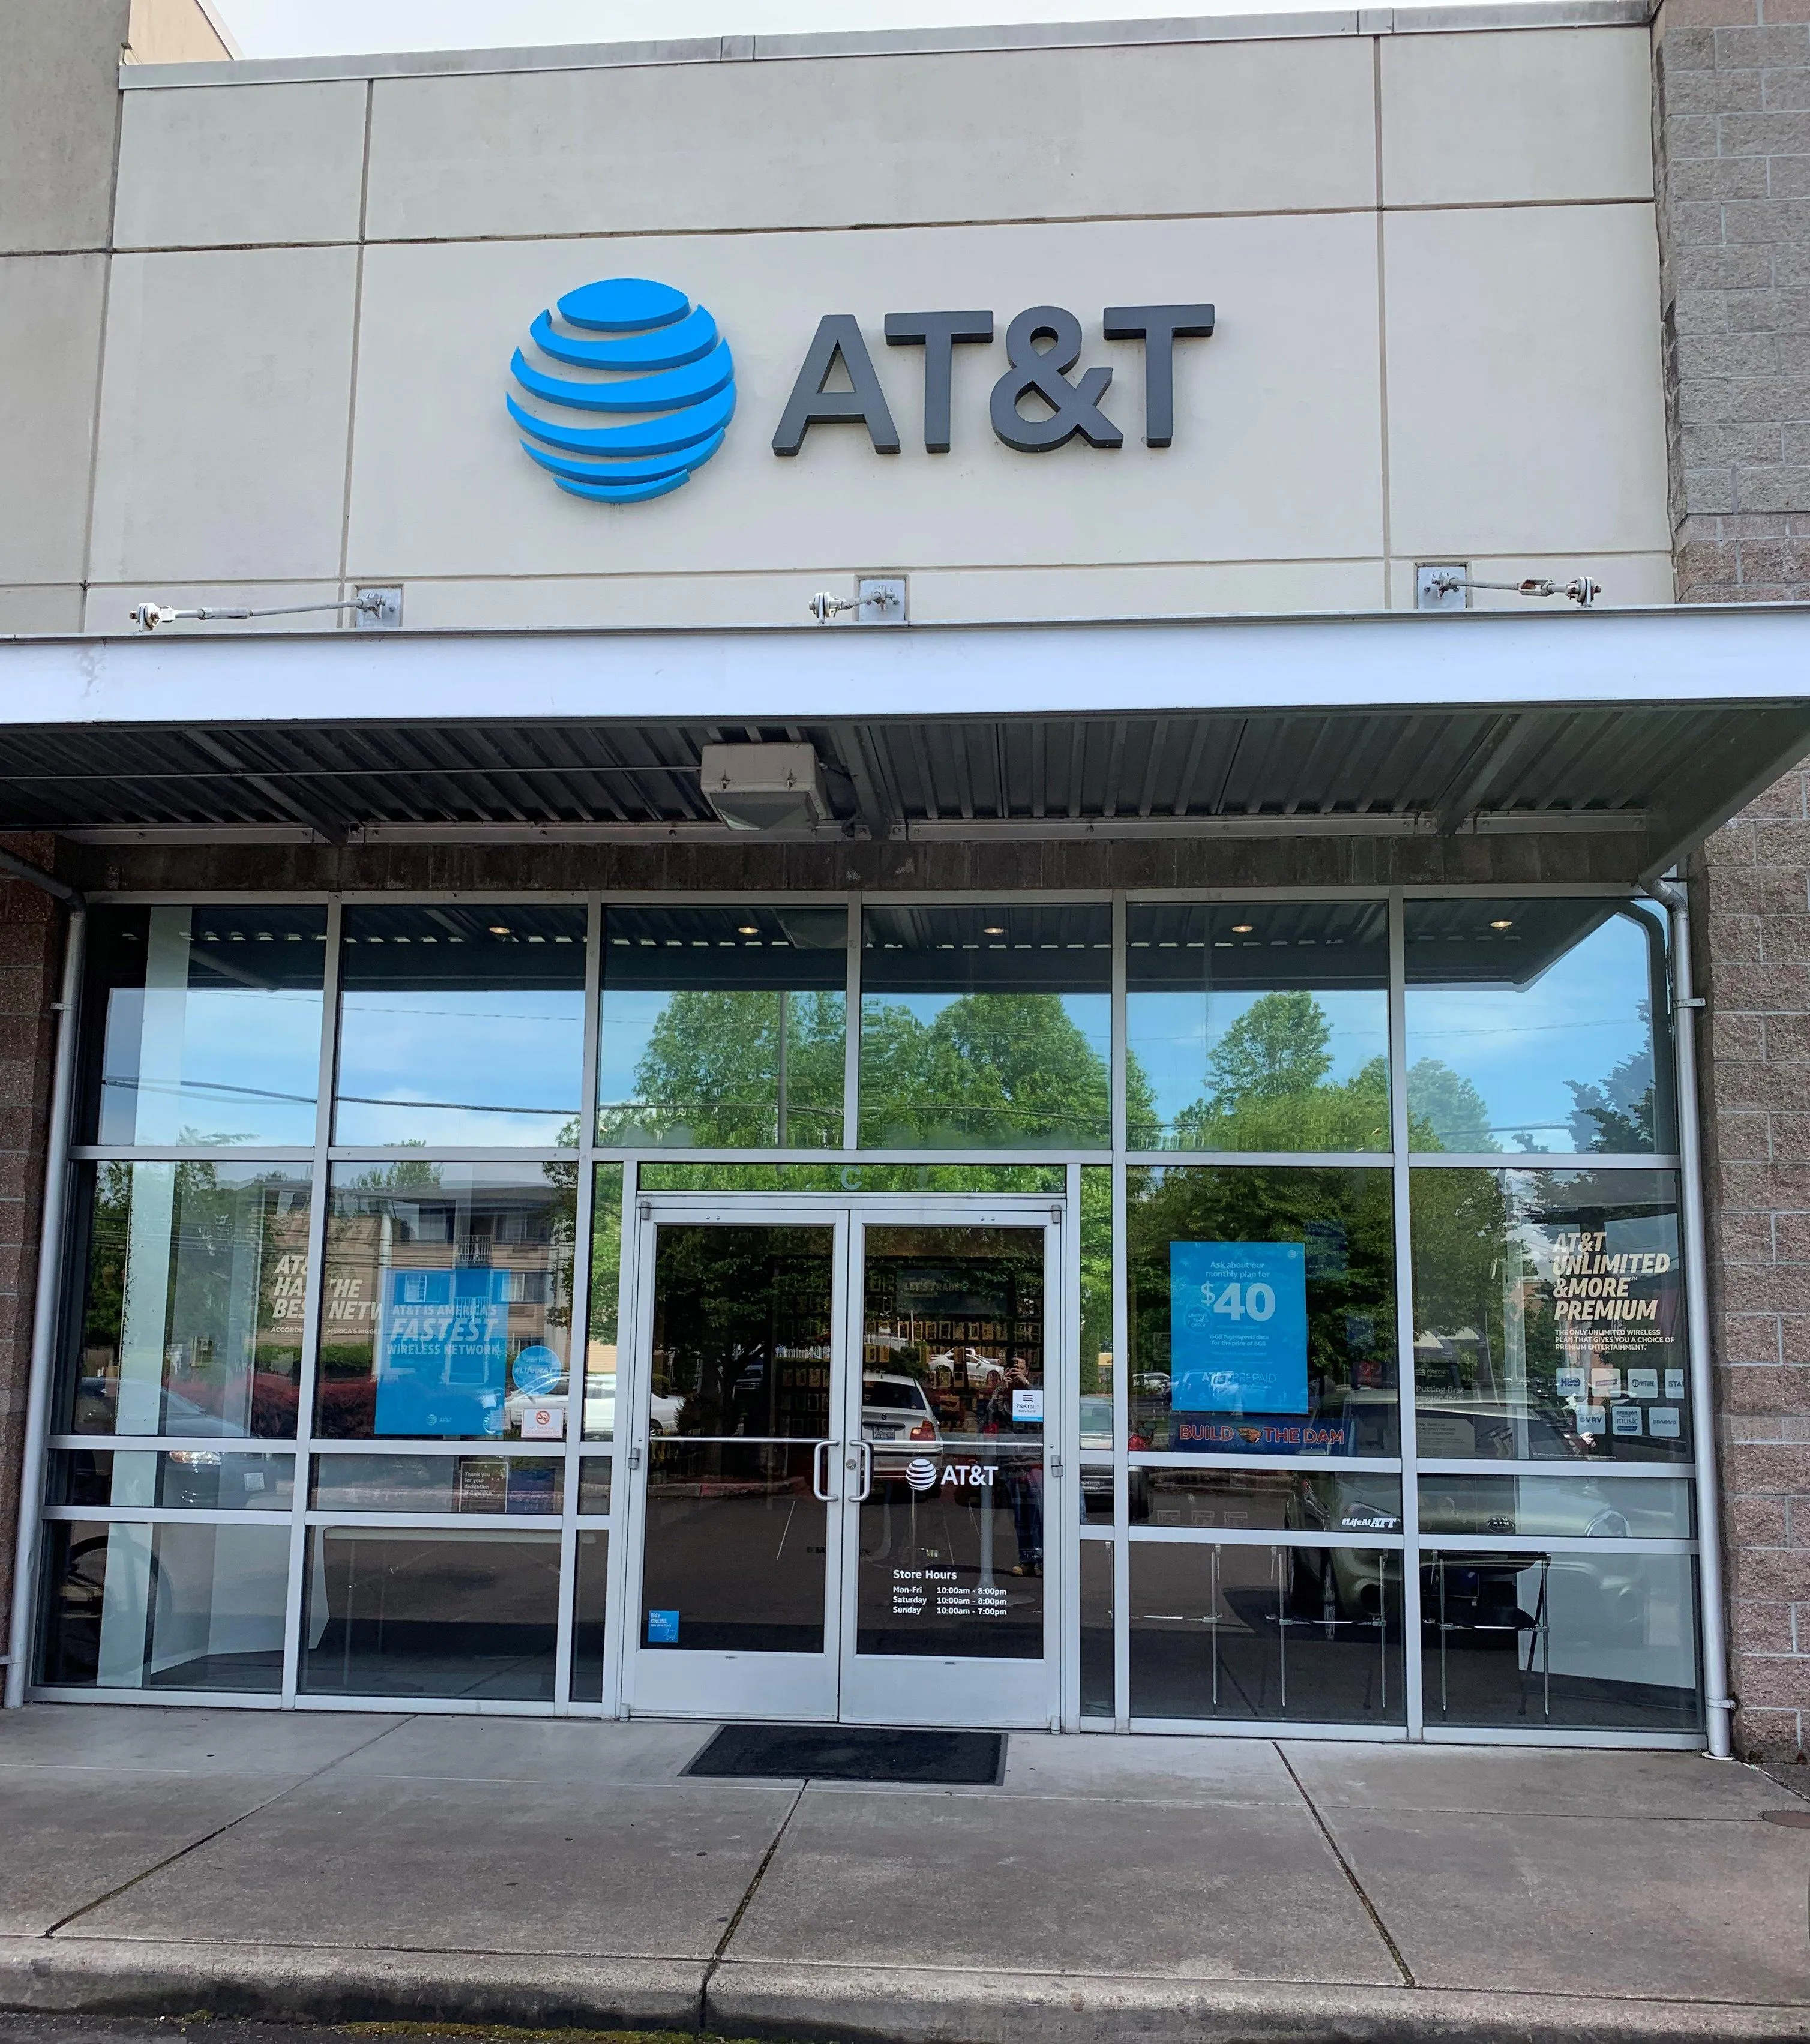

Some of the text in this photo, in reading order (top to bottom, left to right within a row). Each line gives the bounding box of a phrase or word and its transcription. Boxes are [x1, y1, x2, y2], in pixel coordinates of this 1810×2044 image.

[772, 304, 1215, 456] AT&T
[1553, 1232, 1607, 1252] AT&T
[274, 1255, 308, 1275] AT&
[1553, 1253, 1670, 1275] UNLIMITED
[273, 1276, 307, 1296] HA
[393, 1305, 419, 1315] AT&T
[424, 1305, 434, 1315] IS
[1201, 1281, 1276, 1321] $40
[1554, 1299, 1658, 1320] PREMIUM
[390, 1318, 499, 1342] FASTEST
[387, 1344, 499, 1356] WIRELESS NETWORK
[1233, 1372, 1276, 1383] PREPAID
[1416, 1385, 1465, 1394] Putting first
[1179, 1424, 1345, 1445] BUILD THE DAM
[940, 1465, 999, 1486] AT&T
[892, 1569, 957, 1580] Store Hours
[892, 1596, 927, 1604] Saturday
[978, 1598, 1007, 1606] 8:00pm
[978, 1587, 1007, 1596] 8:00pm
[892, 1607, 921, 1615] Sunday
[936, 1607, 970, 1615] 10:00am
[978, 1608, 1007, 1616] 7:00pm
